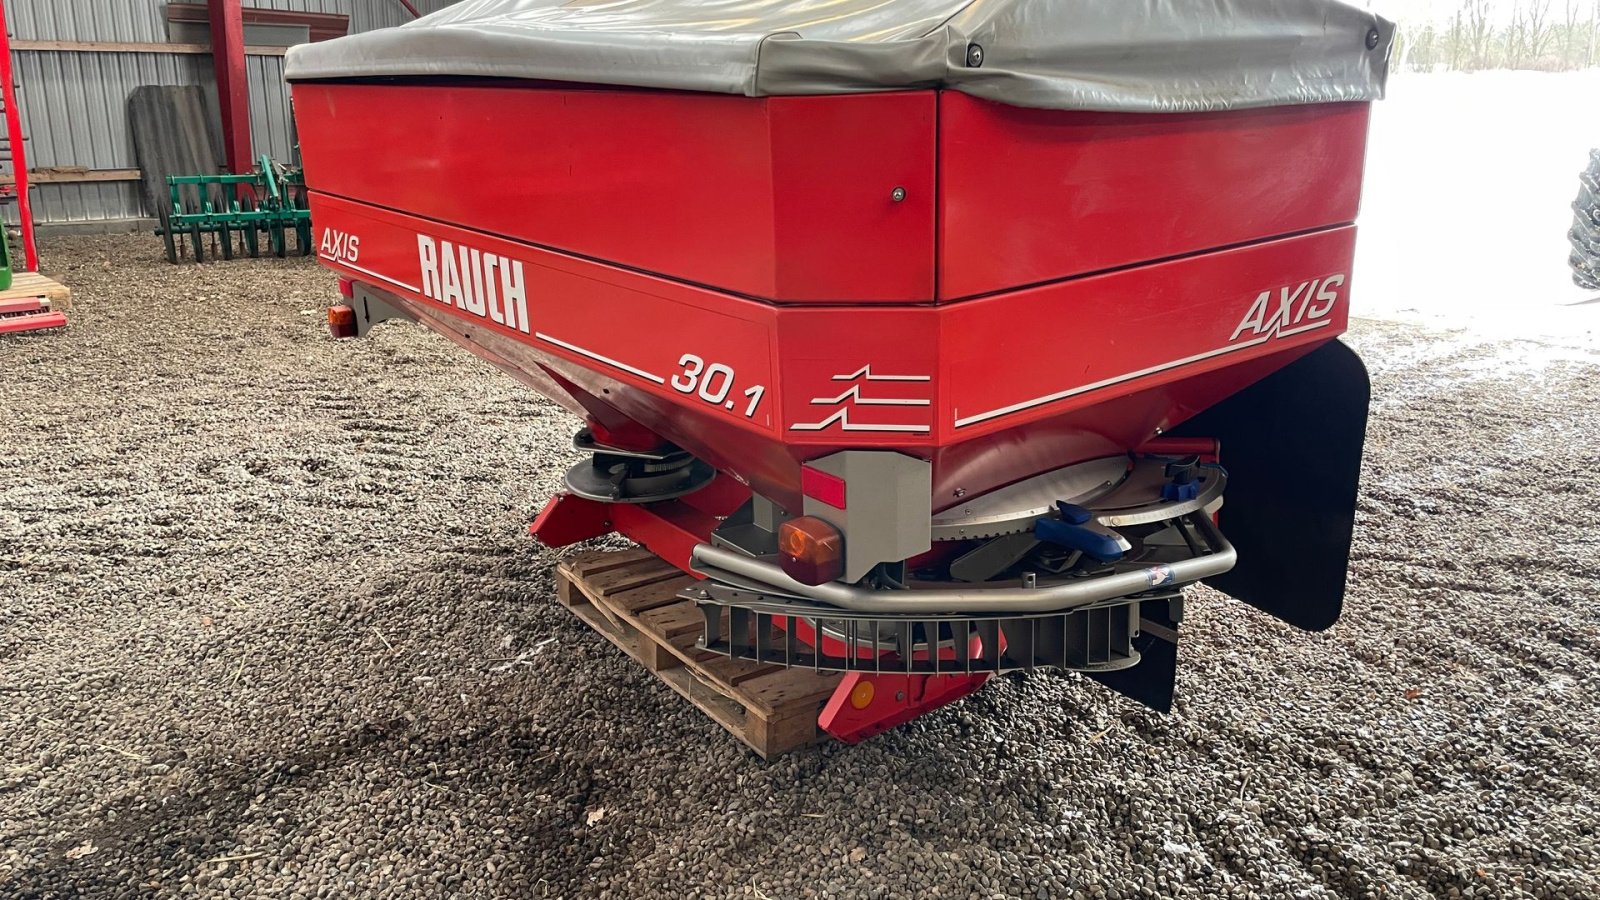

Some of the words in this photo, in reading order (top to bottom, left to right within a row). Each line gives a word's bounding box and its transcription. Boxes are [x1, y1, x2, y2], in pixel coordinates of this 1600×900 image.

[320, 227, 360, 262] AXIS
[416, 233, 530, 334] RAUCH
[1228, 273, 1345, 341] AXIS
[670, 353, 765, 417] 30.1
